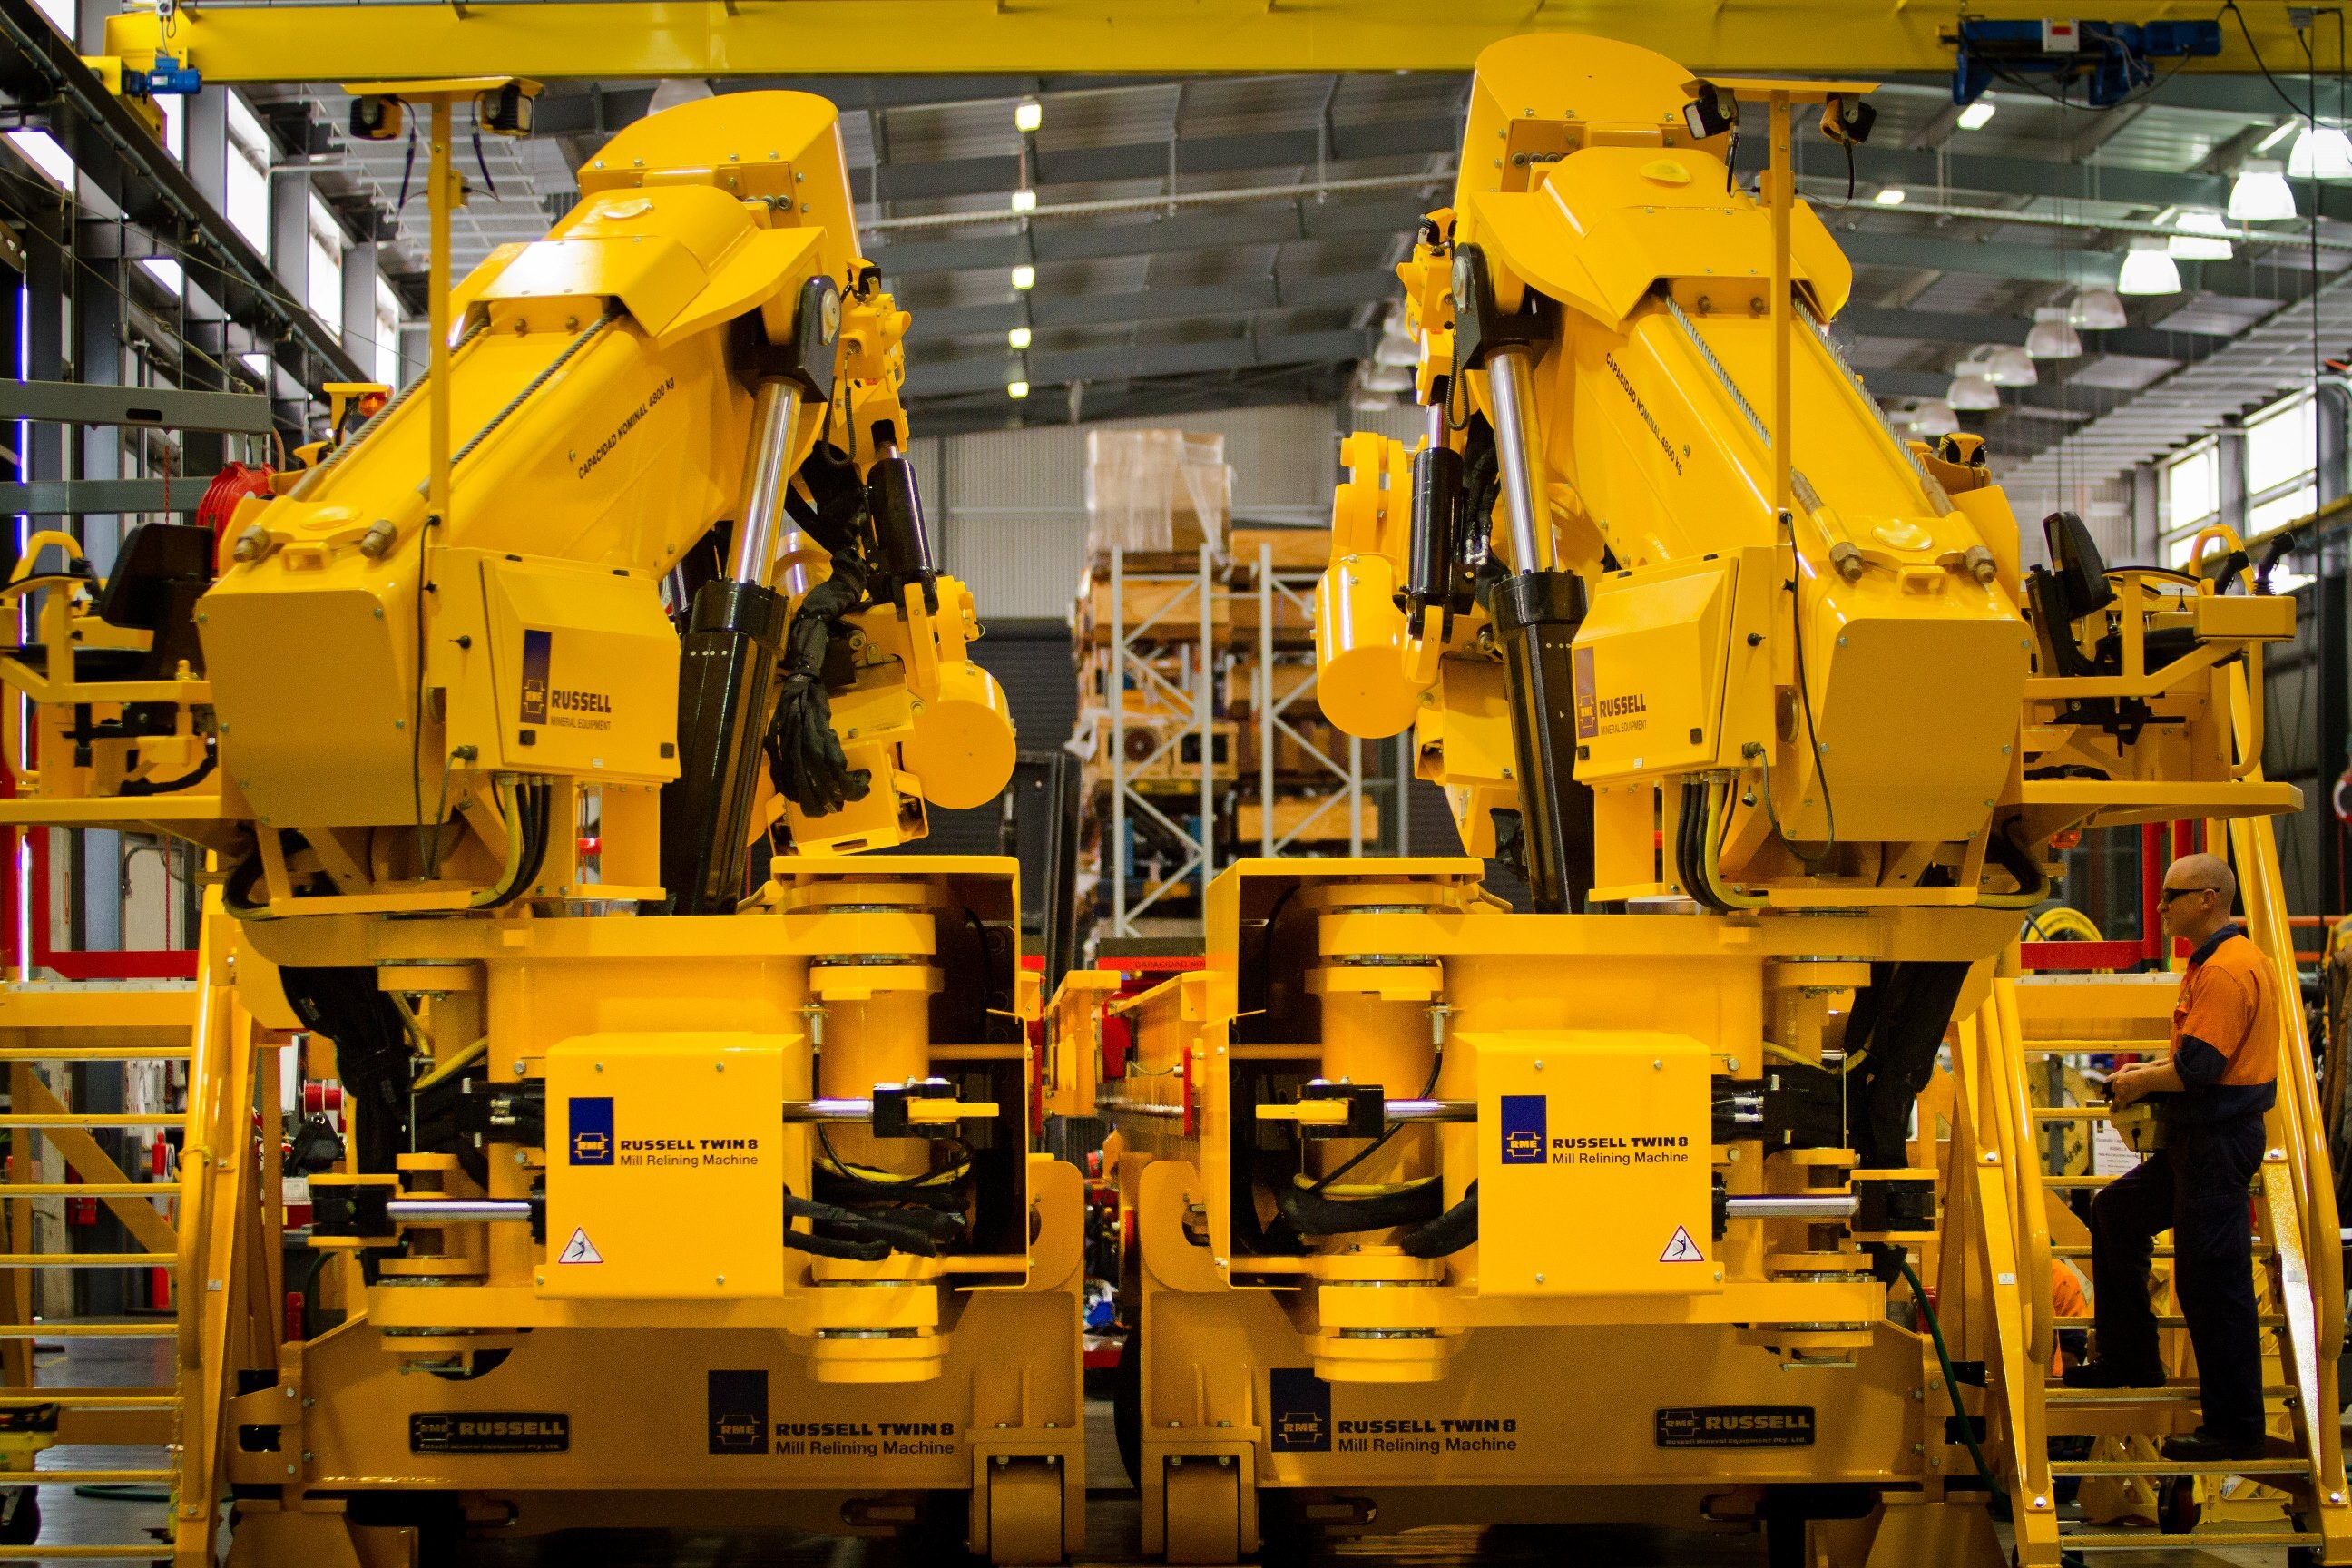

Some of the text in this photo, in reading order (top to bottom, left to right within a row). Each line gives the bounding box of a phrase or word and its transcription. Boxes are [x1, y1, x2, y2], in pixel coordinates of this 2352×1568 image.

[1606, 352, 1682, 475] CAPACIDAD NOMINAL 4800 kg
[578, 377, 674, 479] CAPACIDAD NOMINAL 4800 kg
[552, 690, 612, 713] RUSSELL
[1599, 693, 1647, 718] RUSSELL
[577, 1142, 606, 1150] RME
[621, 1139, 759, 1151] RUSSELL TWIN 8
[1510, 1141, 1538, 1149] RME
[1553, 1136, 1689, 1149] RUSSELL TWIN 8
[621, 1154, 759, 1168] Mill Relining Machine
[1553, 1152, 1689, 1166] Mill Relining Machine
[459, 1422, 565, 1435] RUSSELL
[721, 1425, 755, 1435] RME
[776, 1423, 954, 1436] RUSSELL TWIN 8
[1284, 1423, 1318, 1432] RME
[1338, 1419, 1516, 1433] RUSSELL TWIN 8
[1666, 1419, 1695, 1428] RME
[1705, 1416, 1810, 1430] RUSSELL
[776, 1441, 954, 1457] Mill Relining Machine
[1338, 1437, 1516, 1454] Mill Relining Machine
